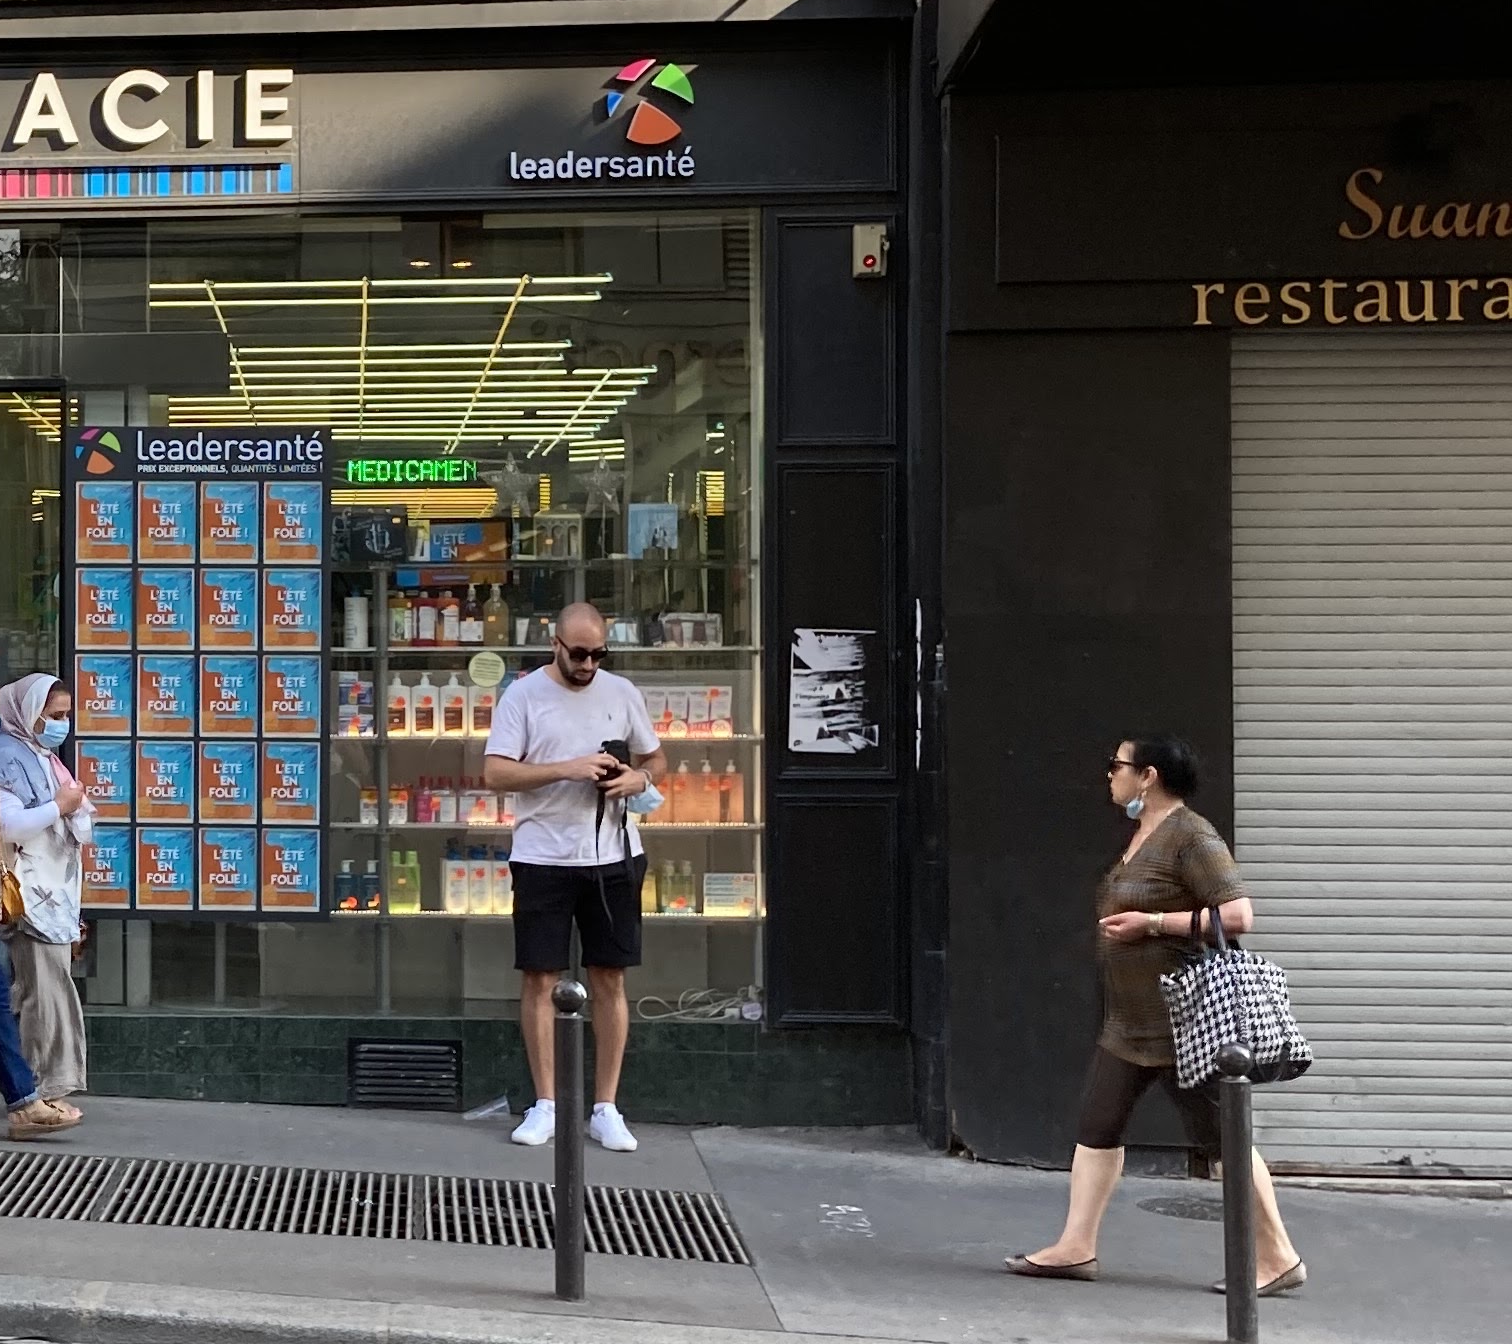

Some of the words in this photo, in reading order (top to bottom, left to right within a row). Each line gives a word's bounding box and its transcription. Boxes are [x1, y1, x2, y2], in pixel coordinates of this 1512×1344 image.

[510, 146, 696, 180] leadersanté
[137, 430, 323, 462] leadersanté
[137, 464, 157, 474] PRIX
[158, 464, 228, 475] EXCEPTIONNELS,
[231, 462, 278, 474] QUANTITÉS
[279, 462, 318, 474] LIMITÉES
[347, 459, 477, 483] MEDICAMEN
[90, 502, 120, 515] L'ÉTÉ
[152, 502, 182, 515] L'ÉTÉ
[214, 502, 244, 515] L'ÉTÉ
[278, 502, 308, 515] L'ÉTÉ
[98, 516, 112, 526] EN
[160, 516, 174, 526] EN
[222, 516, 236, 526] EN
[286, 516, 300, 526] EN
[86, 528, 117, 538] FOLIE
[148, 528, 179, 538] FOLIE
[210, 528, 241, 538] FOLIE
[274, 528, 305, 538] FOLIE
[442, 546, 458, 558] EN
[90, 588, 120, 601] L'ÉTÉ
[150, 588, 180, 601] L'ÉTÉ
[214, 588, 242, 602] L'ÉTÉ
[278, 588, 306, 602] L'ÉTÉ
[98, 602, 112, 612] EN
[158, 602, 172, 612] EN
[220, 603, 236, 613] EN
[284, 603, 300, 613] EN
[86, 614, 117, 624] FOLIE
[146, 614, 177, 624] FOLIE
[210, 614, 240, 625] FOLIE
[274, 614, 304, 625] FOLIE
[90, 674, 118, 687] L'ÉTÉ
[152, 674, 182, 688] L'ÉTÉ
[214, 674, 244, 688] L'ÉTÉ
[278, 674, 306, 688] L'ÉTÉ
[96, 688, 112, 698] EN
[160, 689, 174, 699] EN
[222, 689, 236, 699] EN
[284, 689, 300, 699] EN
[86, 700, 116, 710] FOLIE
[148, 700, 179, 711] FOLIE
[210, 700, 241, 711] FOLIE
[274, 700, 304, 711] FOLIE
[90, 760, 120, 773] L'ÉTÉ
[150, 760, 180, 774] L'ÉTÉ
[214, 762, 242, 775] L'ÉTÉ
[276, 762, 304, 775] L'ÉTÉ
[98, 774, 112, 784] EN
[158, 775, 172, 785] EN
[220, 776, 236, 786] EN
[282, 776, 298, 786] EN
[146, 786, 177, 797] FOLIE
[210, 788, 240, 798] FOLIE
[272, 788, 302, 798] FOLIE
[90, 846, 118, 859] L'ÉTÉ
[150, 846, 180, 860] L'ÉTÉ
[214, 848, 242, 861] L'ÉTÉ
[276, 848, 304, 862] L'ÉTÉ
[96, 860, 112, 870] EN
[158, 861, 172, 871] EN
[220, 862, 236, 872] EN
[282, 863, 298, 873] EN
[146, 872, 177, 883] FOLIE
[210, 874, 240, 884] FOLIE
[272, 874, 302, 885] FOLIE
